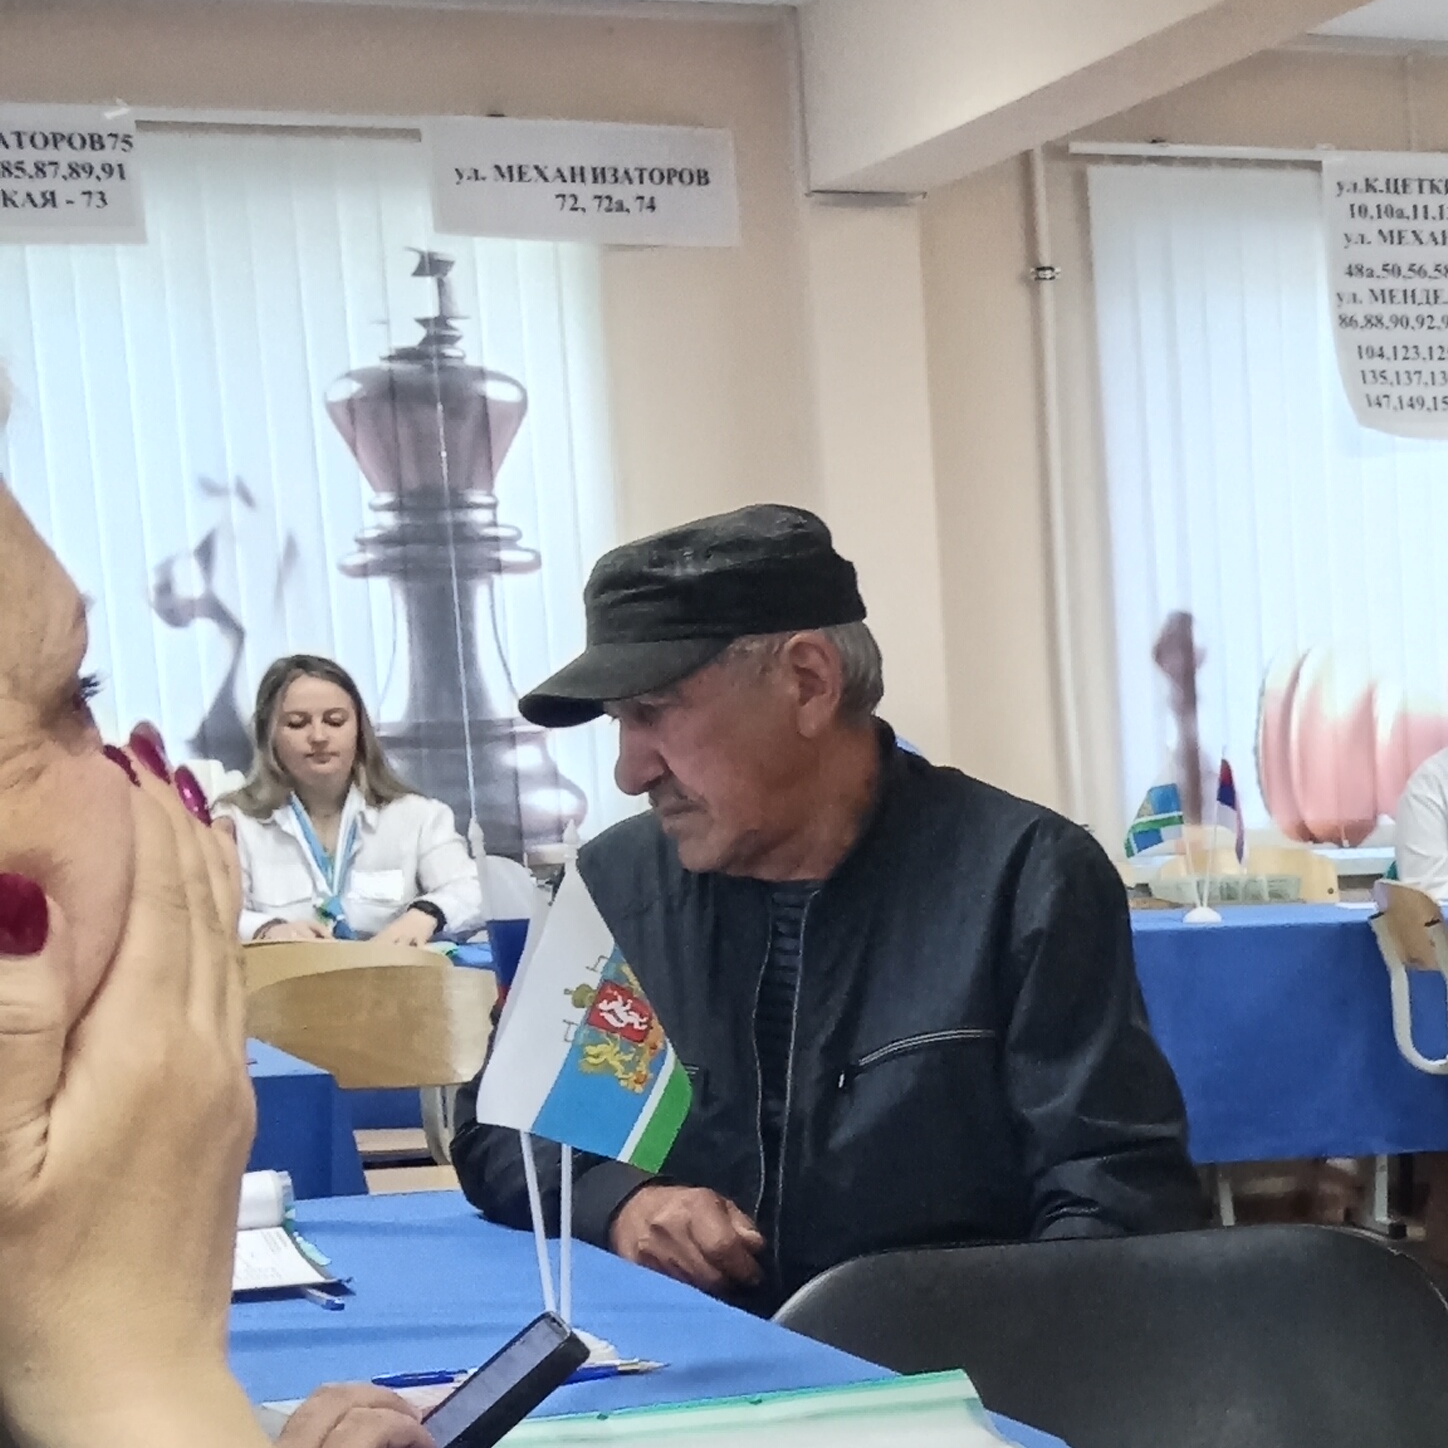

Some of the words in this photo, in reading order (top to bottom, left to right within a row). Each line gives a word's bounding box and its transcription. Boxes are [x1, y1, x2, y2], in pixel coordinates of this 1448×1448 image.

[455, 167, 487, 185] ул.
[494, 163, 711, 186] МЕХАНИЗАТОРОВ
[80, 190, 109, 209] 73
[554, 193, 586, 213] 72,
[635, 195, 657, 213] 74
